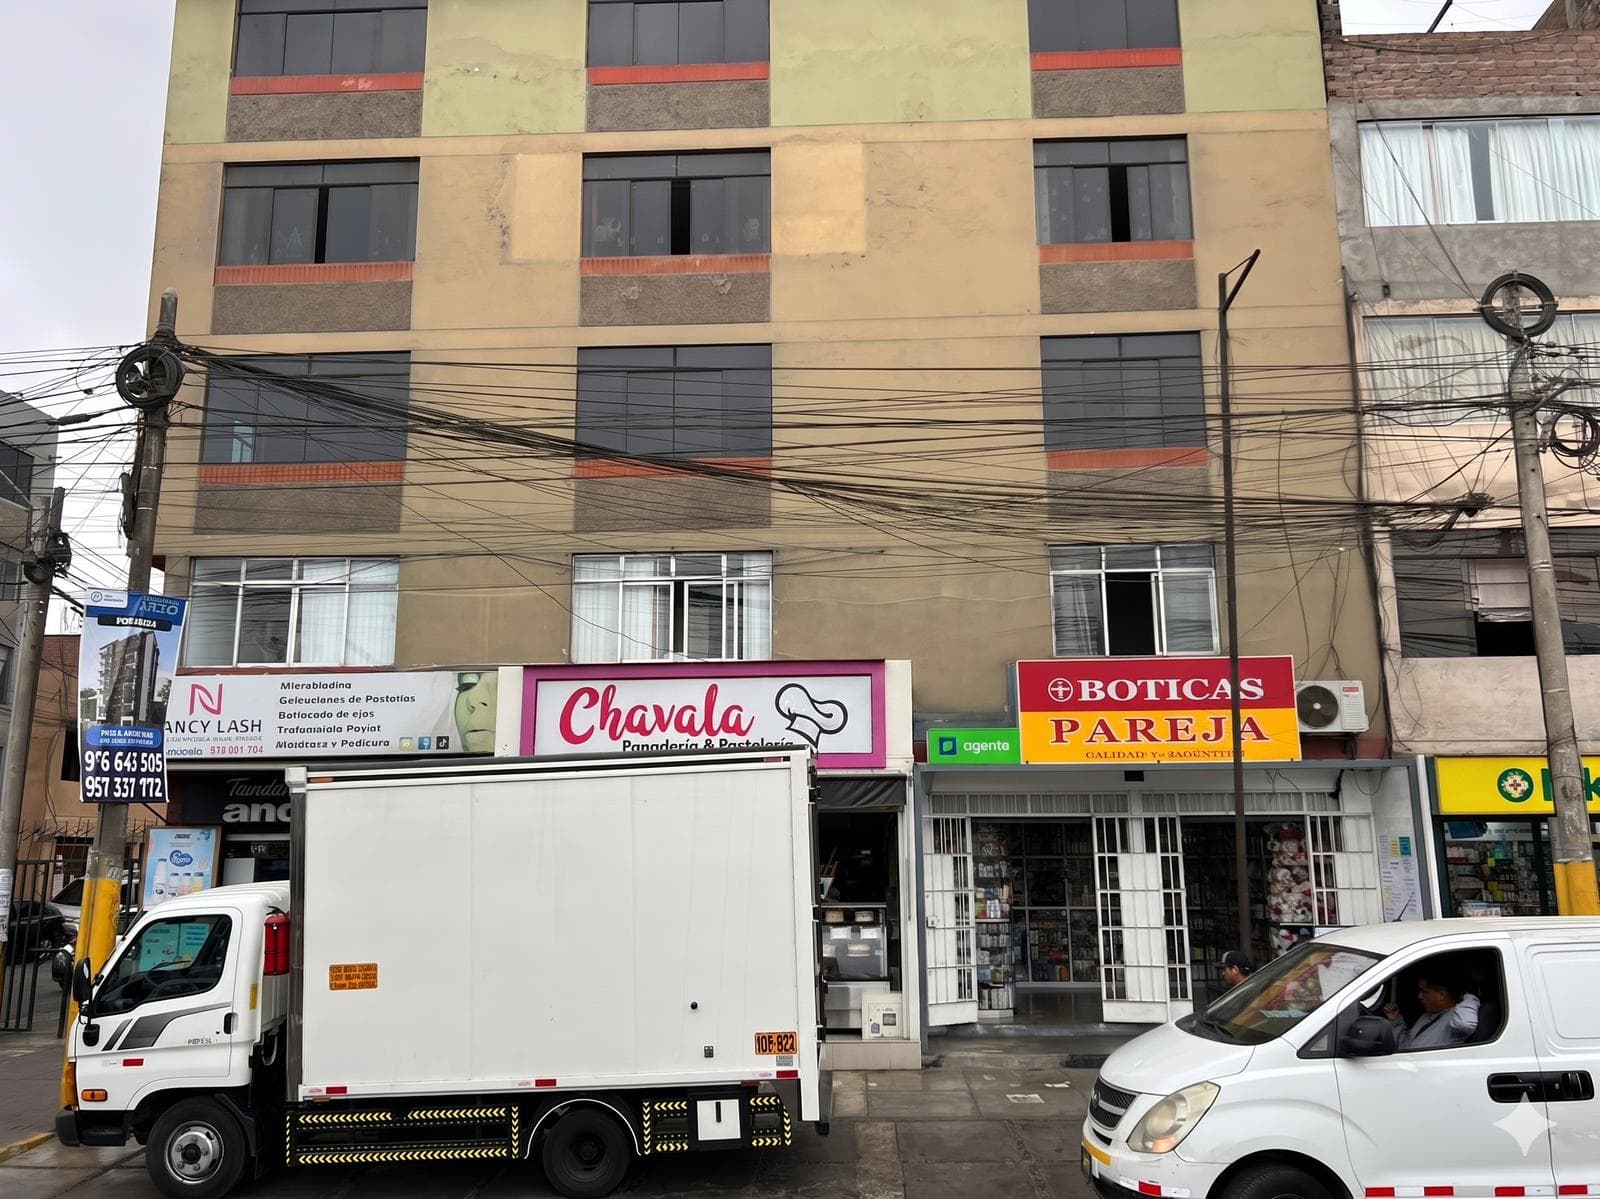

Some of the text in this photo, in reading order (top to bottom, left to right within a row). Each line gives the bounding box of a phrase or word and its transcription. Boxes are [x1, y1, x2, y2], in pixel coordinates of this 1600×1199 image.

[348, 695, 361, 704] de
[1077, 677, 1264, 702] BOTICAS
[336, 710, 349, 718] de
[559, 683, 755, 745] Chavala
[217, 719, 262, 733] LASH
[1049, 715, 1270, 744] PAREJA
[140, 752, 162, 772] 505
[85, 775, 110, 797] 957
[113, 777, 136, 798] 337
